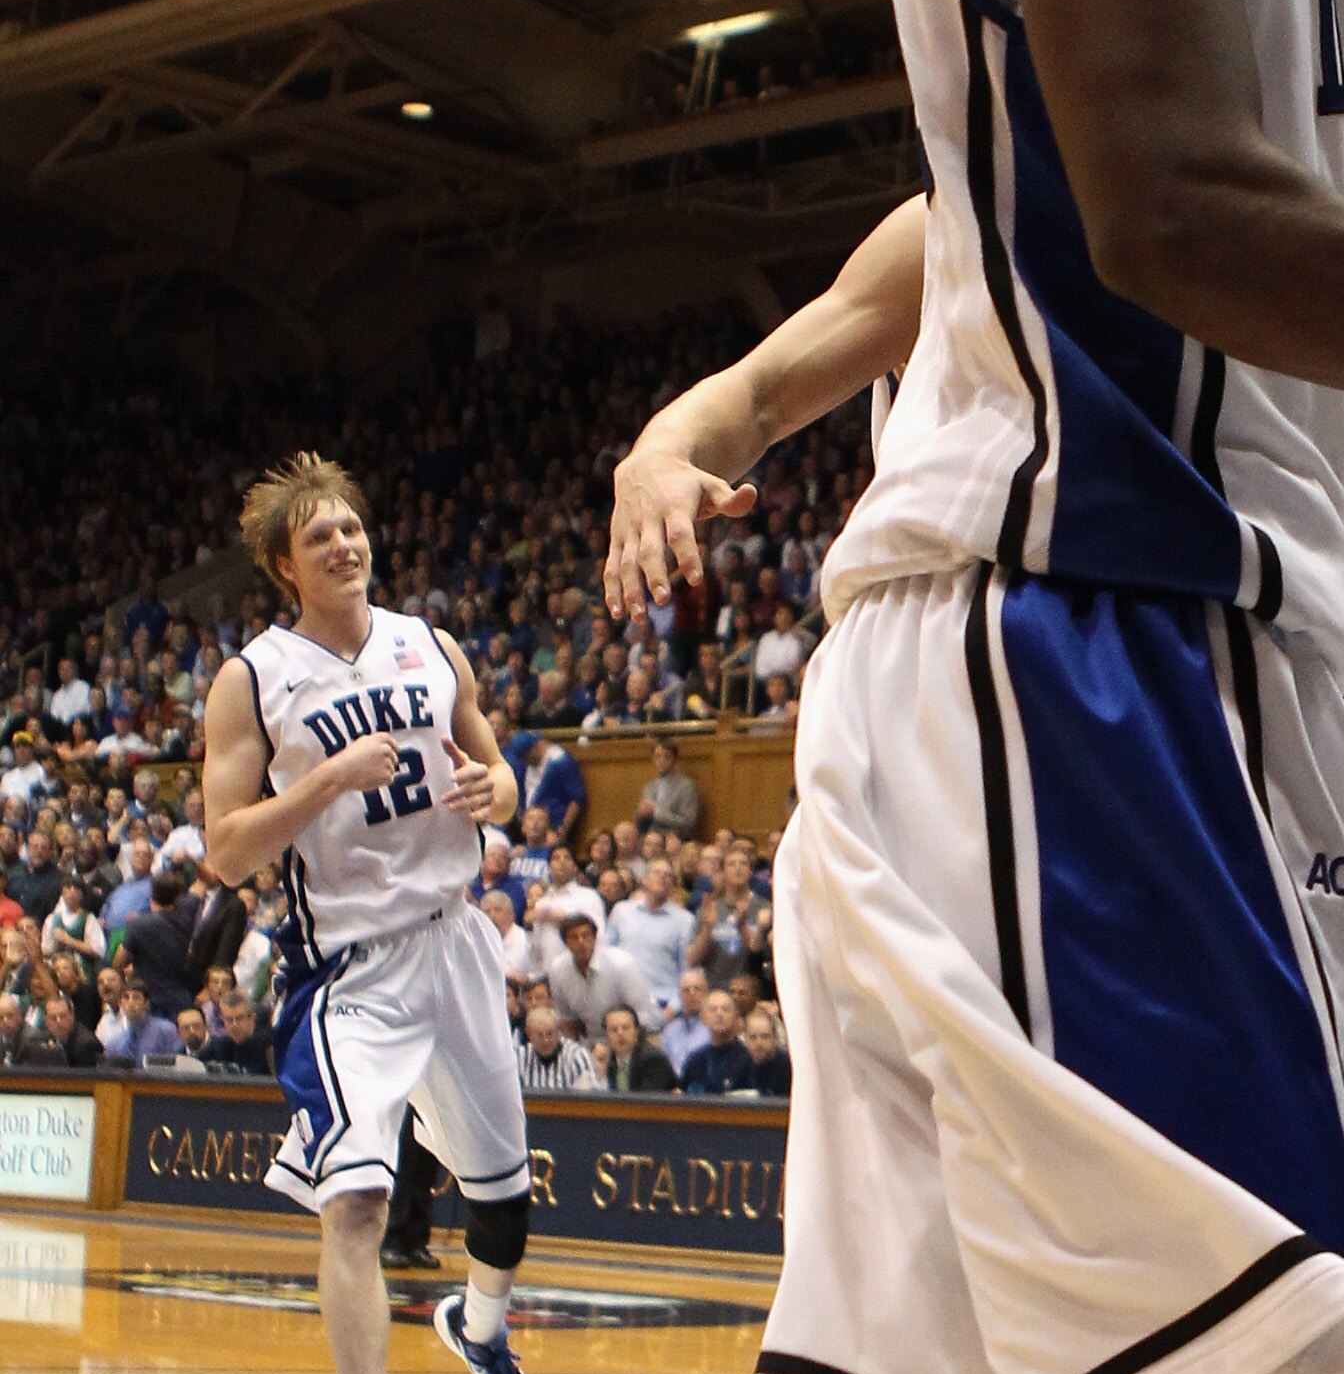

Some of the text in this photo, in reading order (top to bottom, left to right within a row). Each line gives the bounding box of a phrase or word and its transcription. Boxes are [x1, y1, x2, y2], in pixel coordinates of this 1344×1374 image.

[302, 683, 434, 758] DUKE
[364, 746, 433, 826] 12
[335, 1004, 364, 1017] ACC
[0, 1107, 83, 1138] ton Duke
[0, 1145, 72, 1177] olf Club
[592, 1152, 784, 1220] STADIU
